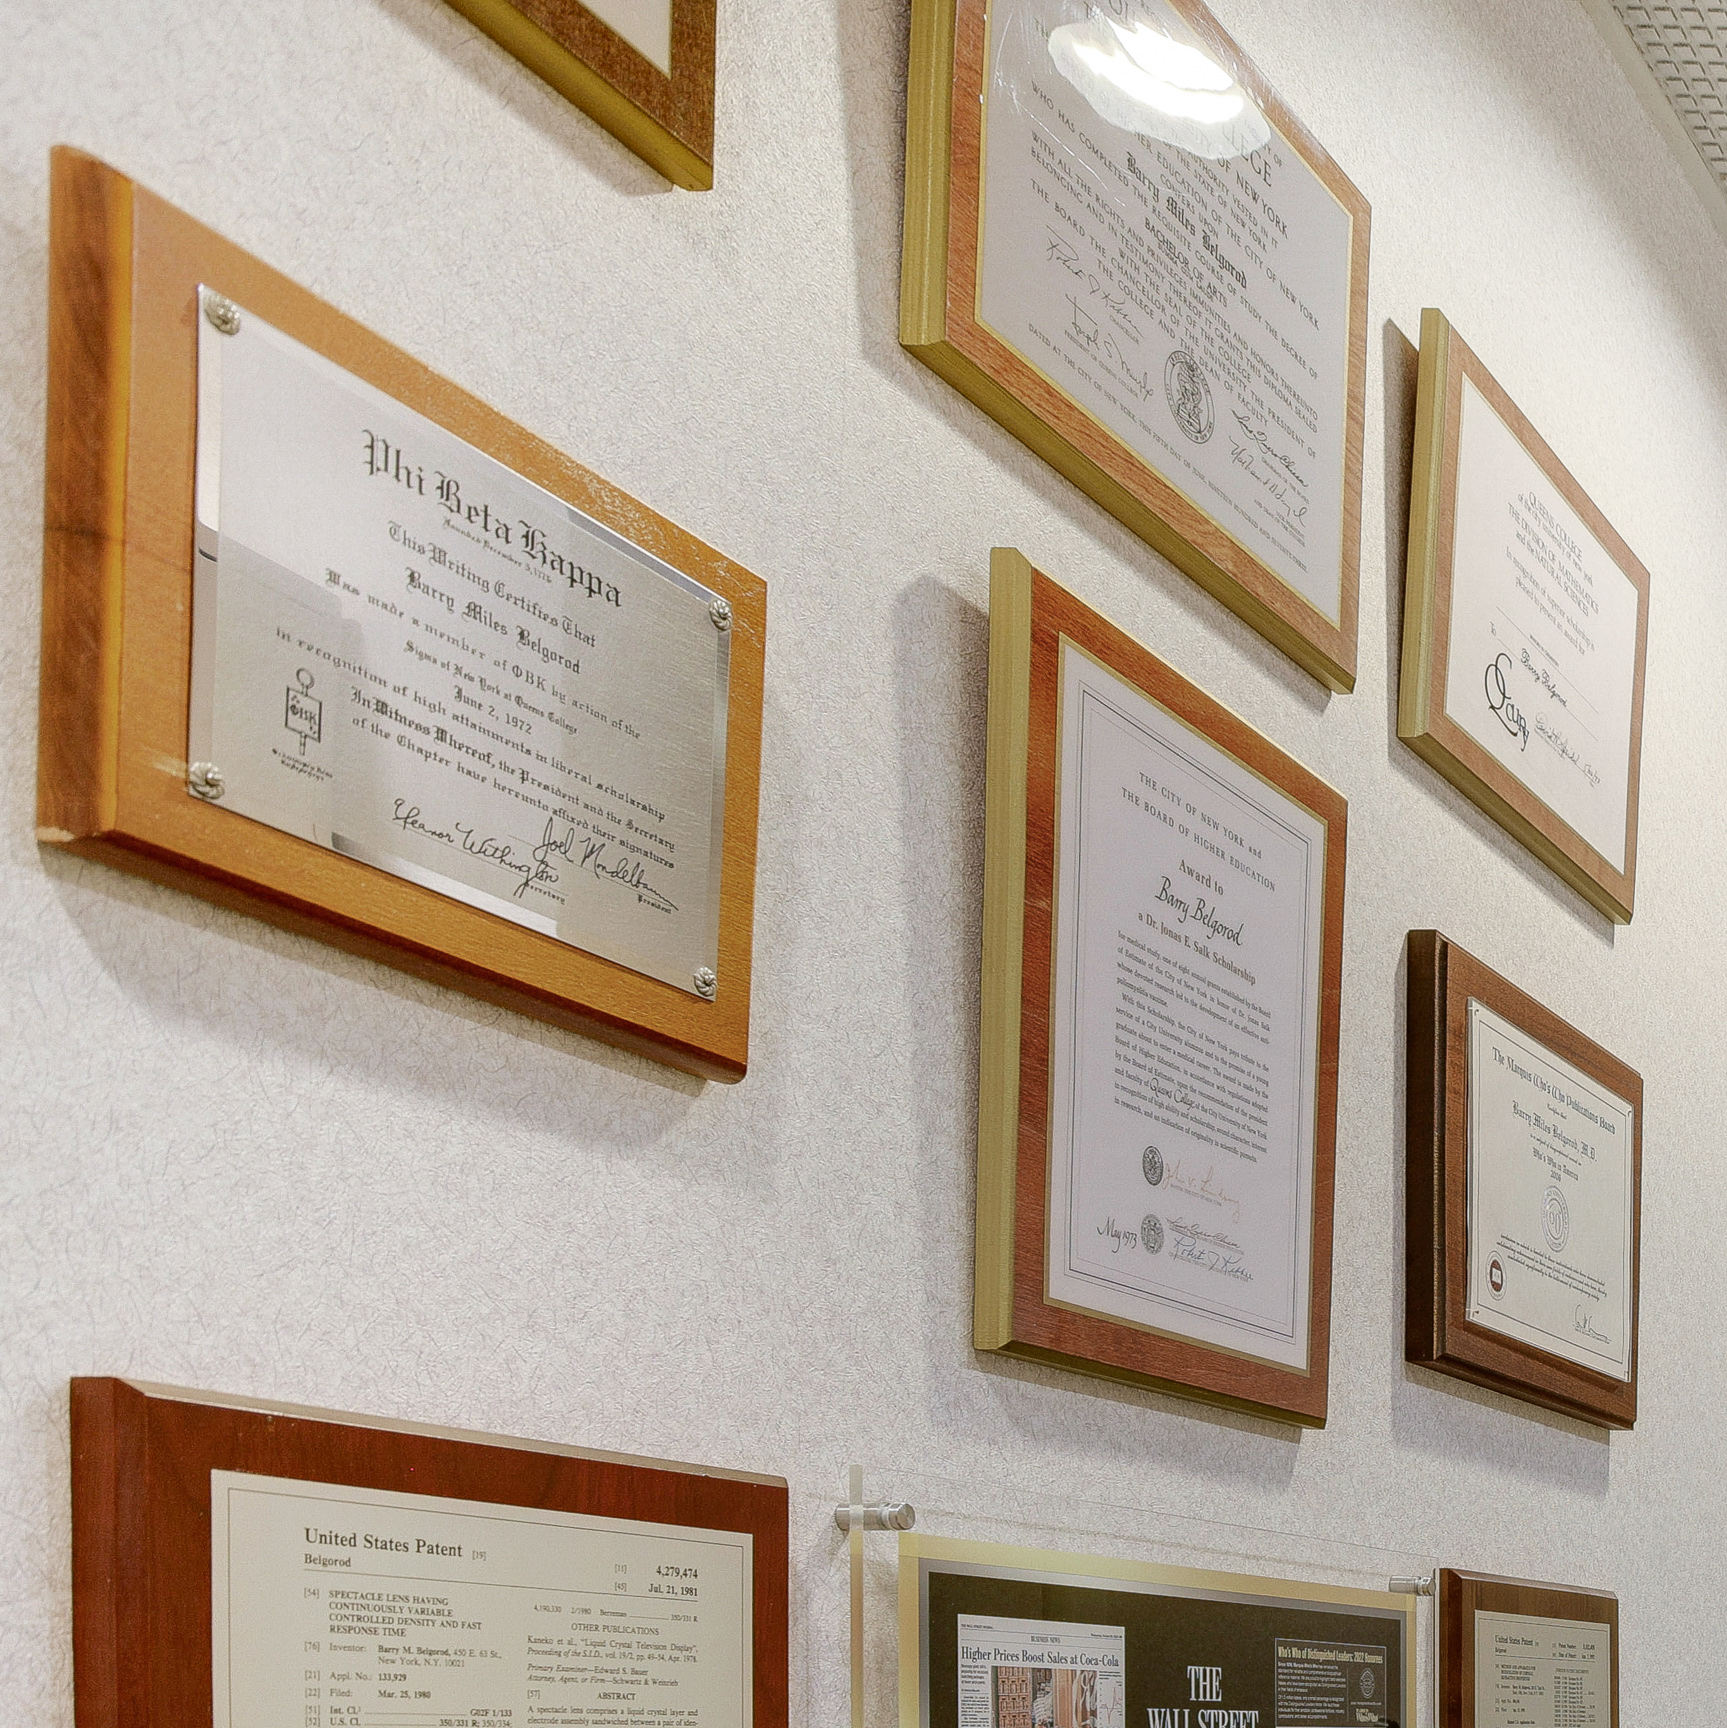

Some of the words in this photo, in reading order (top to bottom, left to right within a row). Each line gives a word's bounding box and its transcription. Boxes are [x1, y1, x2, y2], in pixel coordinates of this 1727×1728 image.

[1127, 151, 1160, 202] Barry
[1166, 196, 1197, 237] Miles
[1145, 216, 1190, 268] BACHELOR
[1193, 266, 1205, 281] OF
[1206, 281, 1228, 307] ARTS
[362, 429, 424, 496] Phi
[433, 470, 513, 544] Beta
[518, 519, 622, 608] Kappa
[1556, 523, 1582, 562] COLLEGE
[387, 520, 425, 555] This
[428, 542, 490, 594] Writing
[494, 580, 559, 627] Certifies
[561, 615, 596, 648] That
[405, 566, 455, 613] Barry
[461, 601, 508, 637] Miles
[516, 626, 581, 675] Belgorod
[298, 639, 388, 688] recognition
[393, 684, 409, 697] of
[413, 691, 447, 716] high
[451, 713, 532, 756] attainments
[551, 757, 592, 785] liberal
[596, 782, 666, 823] scholarship
[453, 685, 484, 711] June
[505, 713, 532, 735] 1972
[352, 717, 365, 730] of
[370, 722, 391, 739] the
[397, 735, 451, 768] Chapter
[457, 761, 488, 783] have
[493, 778, 549, 812] hereunto
[552, 806, 590, 830] affixed
[592, 824, 617, 843] their
[619, 839, 675, 869] signatures
[372, 697, 431, 736] Witness
[499, 760, 516, 776] the
[519, 768, 580, 806] President
[583, 801, 604, 817] and
[606, 811, 622, 826] the
[626, 820, 675, 853] Secretary
[1139, 771, 1158, 792] THE
[1161, 786, 1182, 807] CITY
[1185, 802, 1197, 816] OF
[1200, 812, 1220, 831] NEW
[1223, 826, 1245, 848] YORK
[1248, 845, 1262, 860] and
[1121, 786, 1140, 807] THE
[1144, 801, 1175, 828] BOARD
[1178, 823, 1190, 837] OF
[1193, 832, 1226, 860] HIGHER
[1229, 855, 1276, 892] EDUCATION
[1178, 859, 1212, 889] Award
[1214, 879, 1224, 896] to
[1155, 875, 1190, 924] Barry
[1190, 897, 1244, 946] Belgorod
[1146, 914, 1159, 930] Dr.
[1161, 922, 1182, 944] Jonas
[1193, 940, 1210, 960] Salk
[1212, 951, 1256, 987] Scholarship
[1097, 1216, 1121, 1253] May
[1122, 1229, 1138, 1250] 1973
[304, 1527, 357, 1547] United
[363, 1534, 409, 1553] States
[415, 1539, 462, 1557] Patent
[304, 1554, 351, 1567] Belgorod
[648, 1583, 663, 1594] Jul.
[666, 1584, 678, 1596] 21,
[680, 1586, 698, 1597] 1981
[655, 1565, 698, 1580] 4,279,474
[329, 1589, 384, 1602] SPECTACLE
[386, 1593, 410, 1604] LENS
[412, 1595, 449, 1606] HAVING
[329, 1602, 404, 1614] CONTINUOUSLY
[407, 1607, 453, 1618] VARIABLE
[329, 1613, 395, 1625] CONTROLLED
[397, 1617, 436, 1628] DENSITY
[440, 1619, 458, 1629] AND
[461, 1621, 482, 1630] FAST
[329, 1624, 379, 1636] RESPONSE
[382, 1627, 407, 1637] TIME
[961, 1646, 992, 1664] Higher
[993, 1648, 1020, 1662] Prices
[1022, 1651, 1045, 1663] Boost
[1047, 1653, 1068, 1665] Sales
[1069, 1655, 1078, 1665] at
[1080, 1654, 1119, 1667] Coca-Cola
[1186, 1665, 1222, 1702] THE
